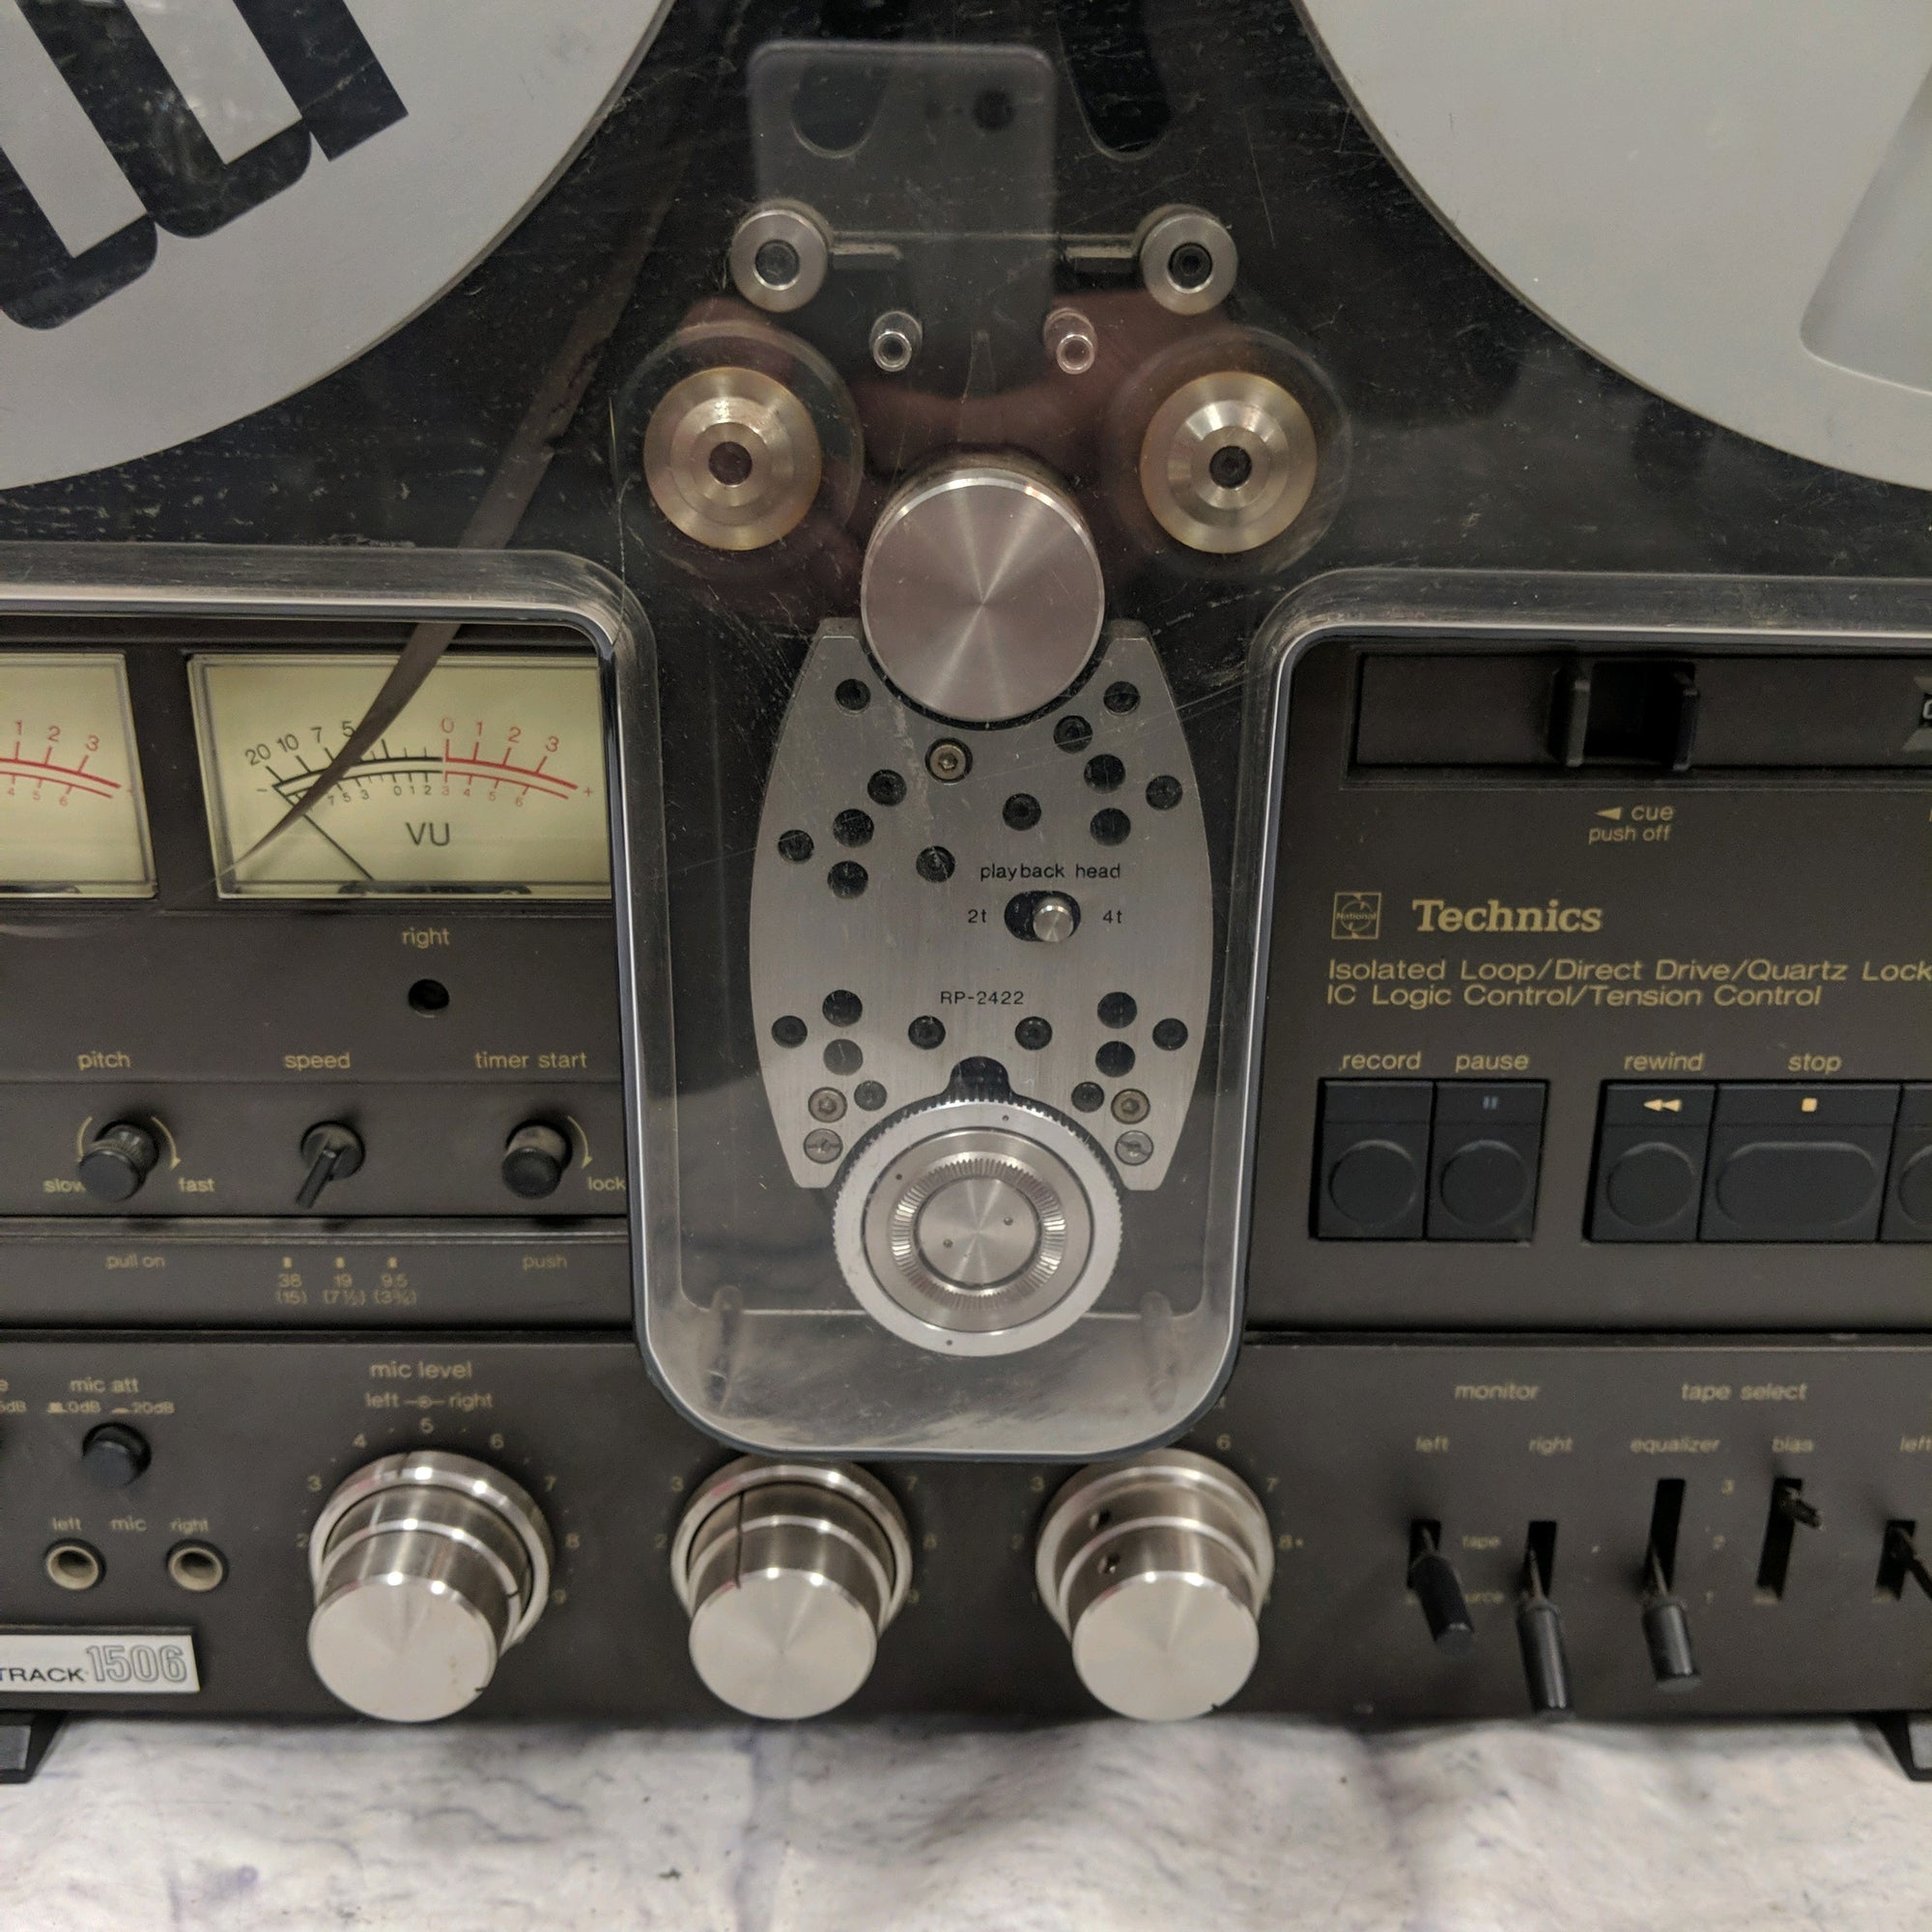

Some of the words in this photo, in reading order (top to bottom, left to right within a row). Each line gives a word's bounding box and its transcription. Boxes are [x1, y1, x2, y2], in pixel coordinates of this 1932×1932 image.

[14, 720, 22, 734] 1
[47, 725, 60, 742] 2
[85, 734, 99, 752] 3
[244, 744, 271, 766] 20
[277, 734, 299, 752] 10
[310, 726, 322, 743] 7
[342, 721, 356, 737] 5
[440, 718, 454, 733] 0
[475, 722, 483, 736] 1
[508, 726, 521, 743] 2
[546, 736, 559, 753] 3
[59, 795, 68, 807] 6
[343, 793, 352, 803] 5
[361, 790, 370, 800] 3
[424, 785, 432, 796] 2
[1631, 806, 1674, 821] cue
[406, 823, 450, 846] VU
[1588, 825, 1636, 844] push
[1642, 824, 1671, 841] off
[980, 864, 1065, 882] playback
[1075, 865, 1122, 879] head
[967, 909, 987, 923] 2t
[1102, 909, 1122, 924] 4t
[1412, 899, 1603, 933] Technics
[402, 928, 450, 949] right
[1329, 959, 1446, 980] Isolated
[1460, 958, 1642, 983] Loop/Direct
[1655, 958, 1847, 981] Drive/Quartz
[1861, 960, 1932, 981] Lock
[940, 990, 1024, 1006] RP-2422
[1327, 983, 1356, 1006] IC
[1372, 984, 1452, 1009] Logic
[1463, 983, 1703, 1007] Control/Tension
[1713, 983, 1823, 1007] Control
[77, 1050, 131, 1070] pitch
[284, 1051, 351, 1070] speed
[474, 1050, 529, 1069] timer
[539, 1051, 587, 1068] start
[1343, 1051, 1422, 1070] record
[1455, 1053, 1530, 1073] pause
[1624, 1051, 1705, 1071] rewind
[1788, 1052, 1842, 1074] stop
[179, 1178, 214, 1192] fast
[587, 1176, 626, 1191] lock
[105, 1252, 139, 1269] pull
[143, 1256, 167, 1268] on
[523, 1254, 568, 1271] push
[370, 1363, 412, 1378] mic
[418, 1361, 472, 1378] level
[70, 1377, 105, 1393] mic
[111, 1378, 139, 1393] att
[1454, 1380, 1539, 1400] monitor
[1681, 1382, 1731, 1401] tape
[1741, 1383, 1806, 1401] select
[365, 1392, 399, 1408] left
[449, 1392, 494, 1411] right
[419, 1417, 434, 1435] 5
[353, 1434, 368, 1449] 4
[490, 1434, 504, 1449] 6
[1414, 1435, 1449, 1452] left
[1528, 1436, 1574, 1456] right
[1631, 1437, 1720, 1454] equalizer
[52, 1517, 82, 1532] left
[108, 1517, 146, 1532] mic
[169, 1518, 210, 1535] right
[0, 1667, 85, 1682] TRACK
[86, 1644, 187, 1683] 1506
